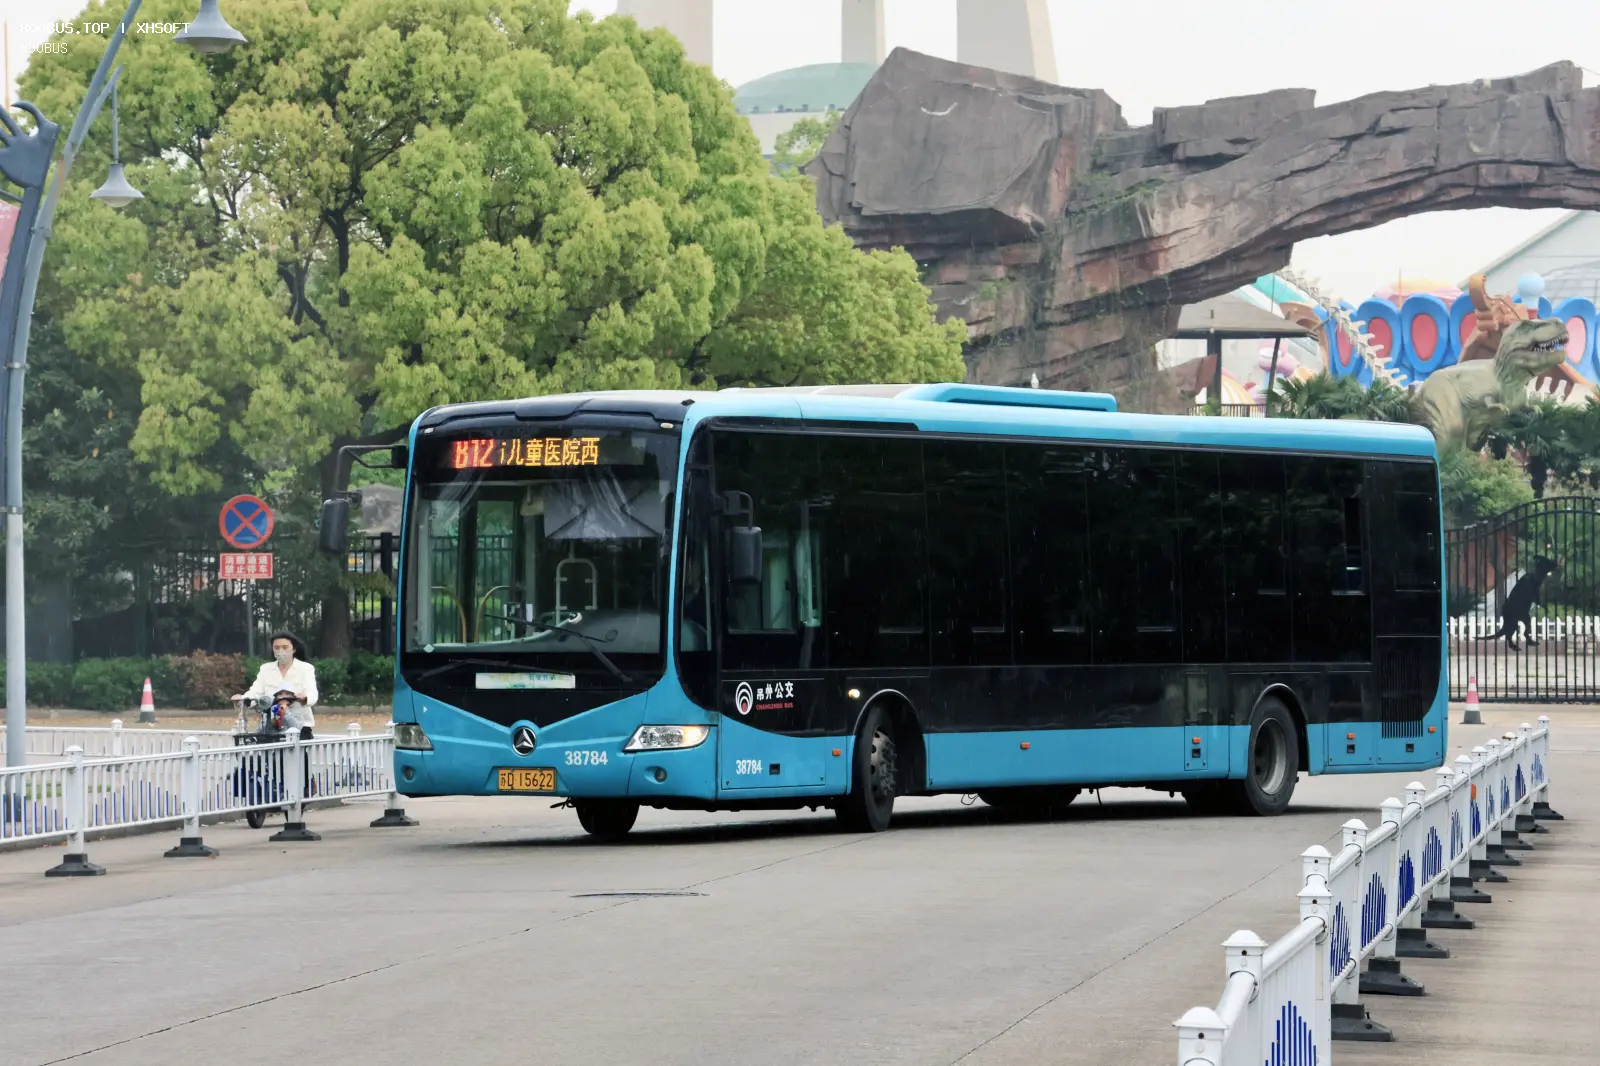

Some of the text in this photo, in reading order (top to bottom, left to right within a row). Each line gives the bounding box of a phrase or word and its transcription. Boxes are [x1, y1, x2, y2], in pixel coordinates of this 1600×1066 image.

[453, 438, 495, 469] B12
[565, 750, 609, 766] 38784
[735, 759, 763, 775] 38784
